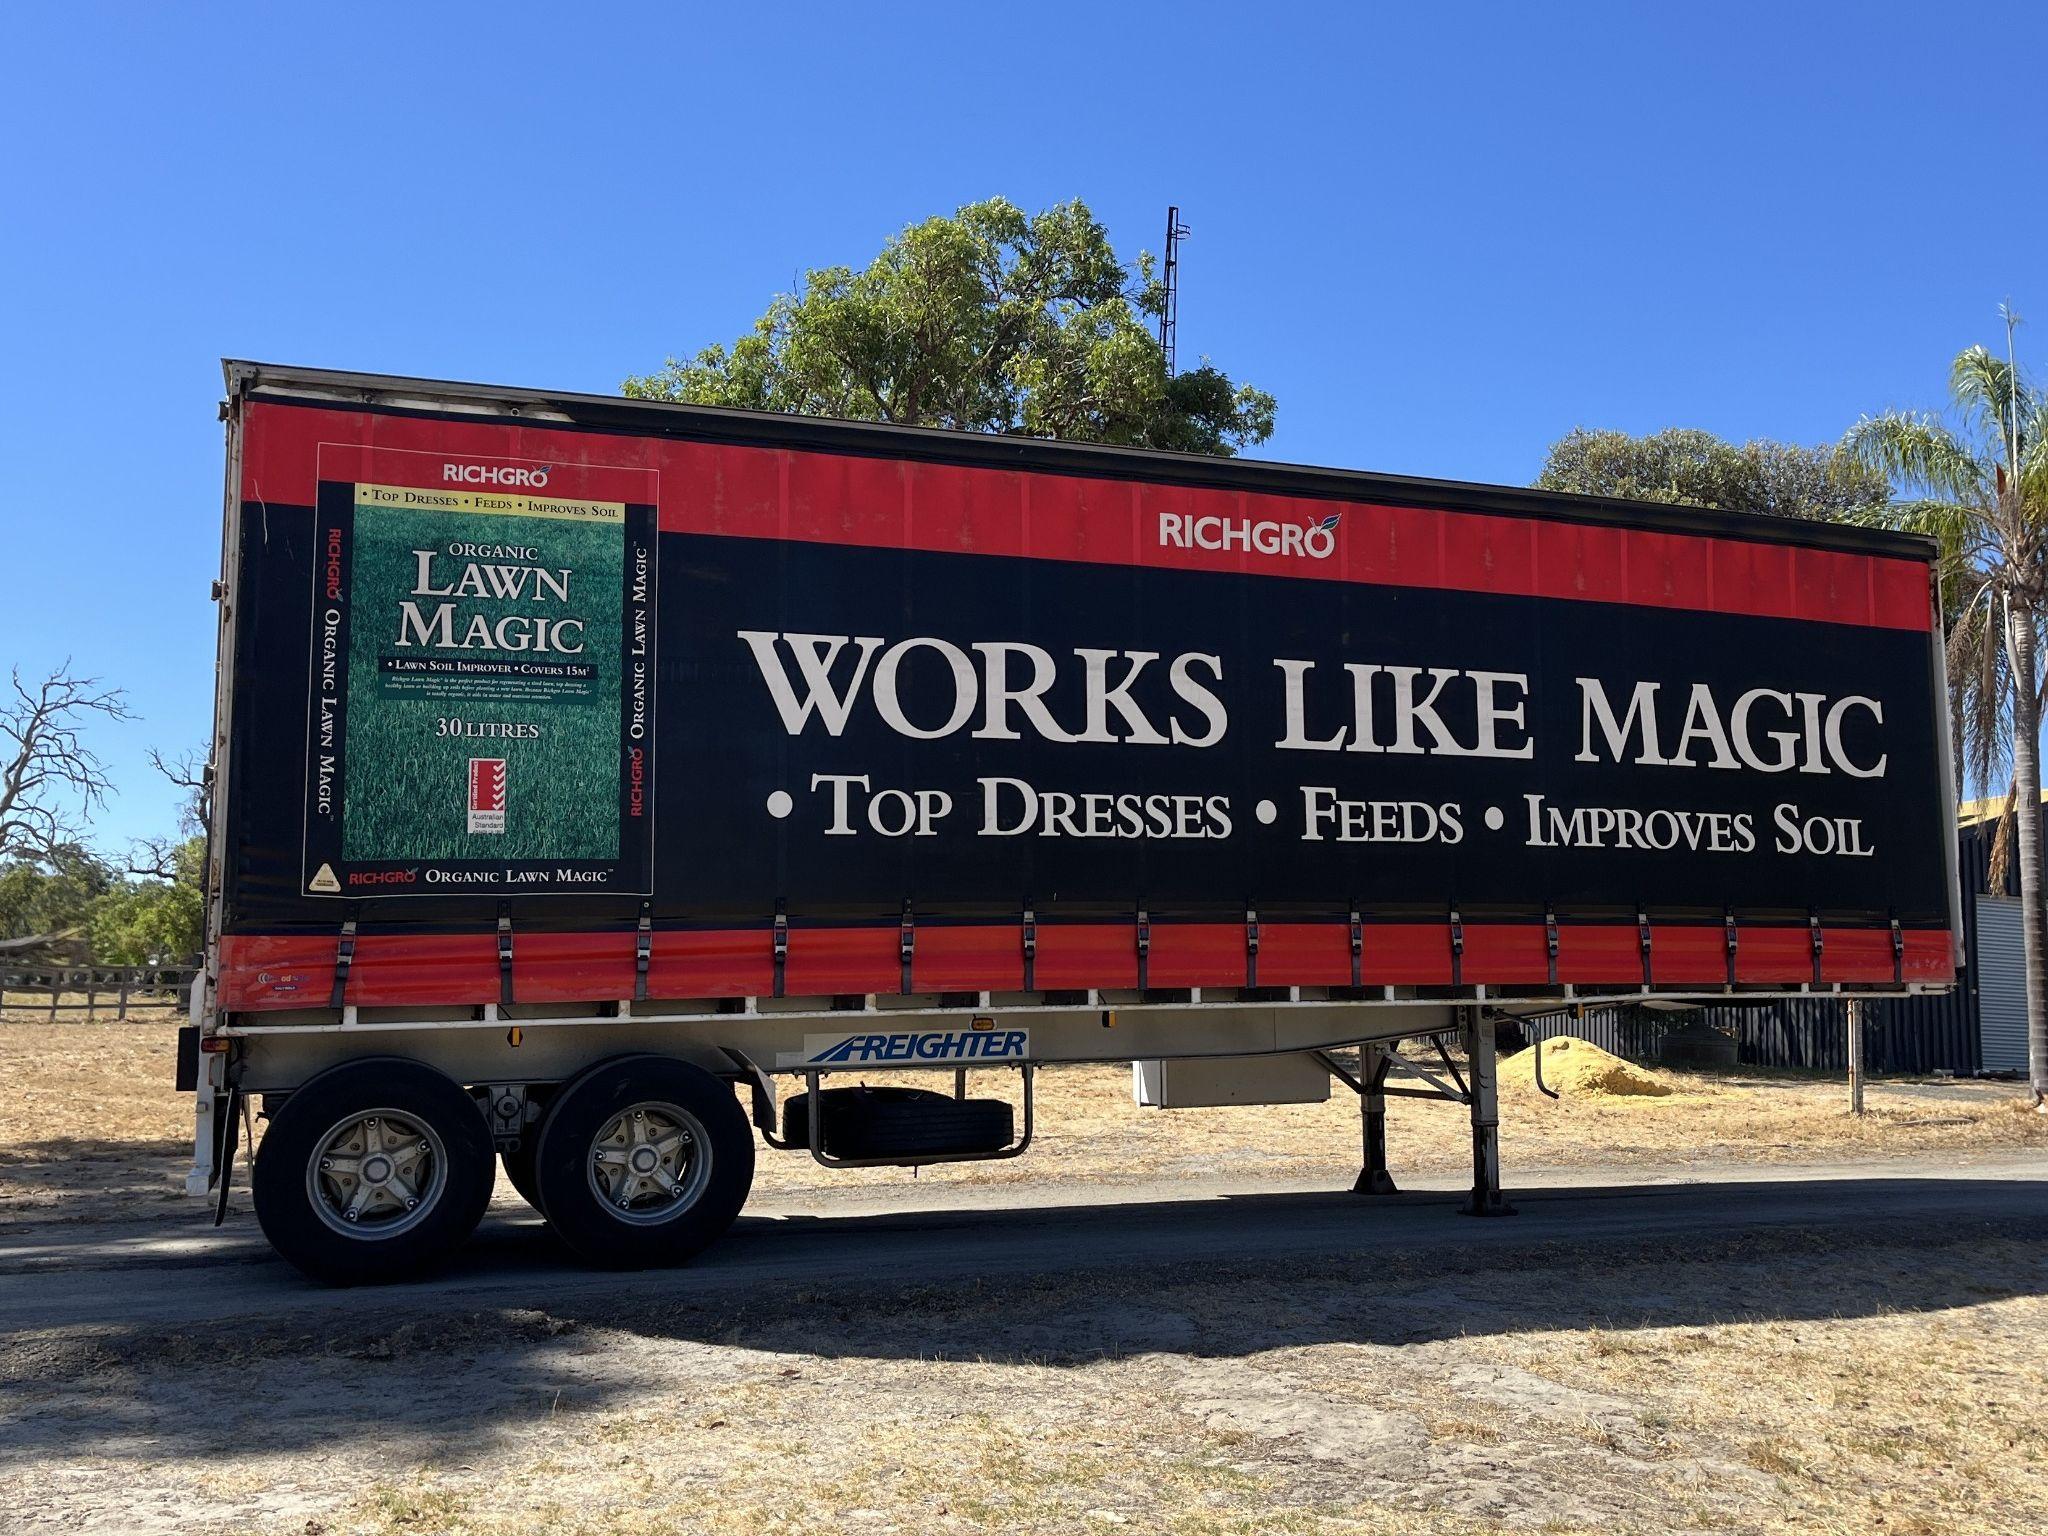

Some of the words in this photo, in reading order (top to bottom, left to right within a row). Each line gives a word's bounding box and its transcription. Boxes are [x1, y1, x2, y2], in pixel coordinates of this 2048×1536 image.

[443, 463, 548, 488] RICHGRO
[372, 489, 399, 501] TOP
[405, 492, 459, 506] DRESSES
[475, 497, 512, 509] FEEDS
[528, 500, 586, 516] IMPROVES
[591, 506, 618, 518] SOIL
[449, 543, 538, 560] ORGANIC
[1159, 512, 1335, 559] RICHGRO
[326, 528, 341, 600] RICHGRO
[410, 550, 572, 602] LAWN
[322, 608, 341, 690] ORGANIC
[394, 601, 584, 654] MAGIC
[631, 609, 646, 657] LAWN
[395, 659, 427, 670] LAWN
[429, 660, 455, 671] SOIL
[457, 661, 511, 673] IMPROVER
[521, 664, 563, 675] COVERS
[321, 697, 337, 748] LAWN
[630, 662, 645, 739] ORGANIC
[737, 630, 1228, 747] WORKS
[1273, 658, 1533, 760] LIKE
[1574, 676, 1887, 779] MAGIC
[435, 717, 462, 737] 30
[465, 722, 539, 739] LITRES
[631, 748, 644, 817] RICHGRO
[811, 773, 952, 836] TOP
[976, 777, 1232, 840] DRESSES
[1300, 786, 1462, 844] FEEDS
[1523, 794, 1755, 853] IMPROVES
[1774, 803, 1874, 857] SOIL
[349, 871, 416, 885] RICHGRO
[425, 869, 500, 883] ORGANIC
[506, 869, 549, 883] LAWN
[826, 1031, 1027, 1062] FREIGHTER
